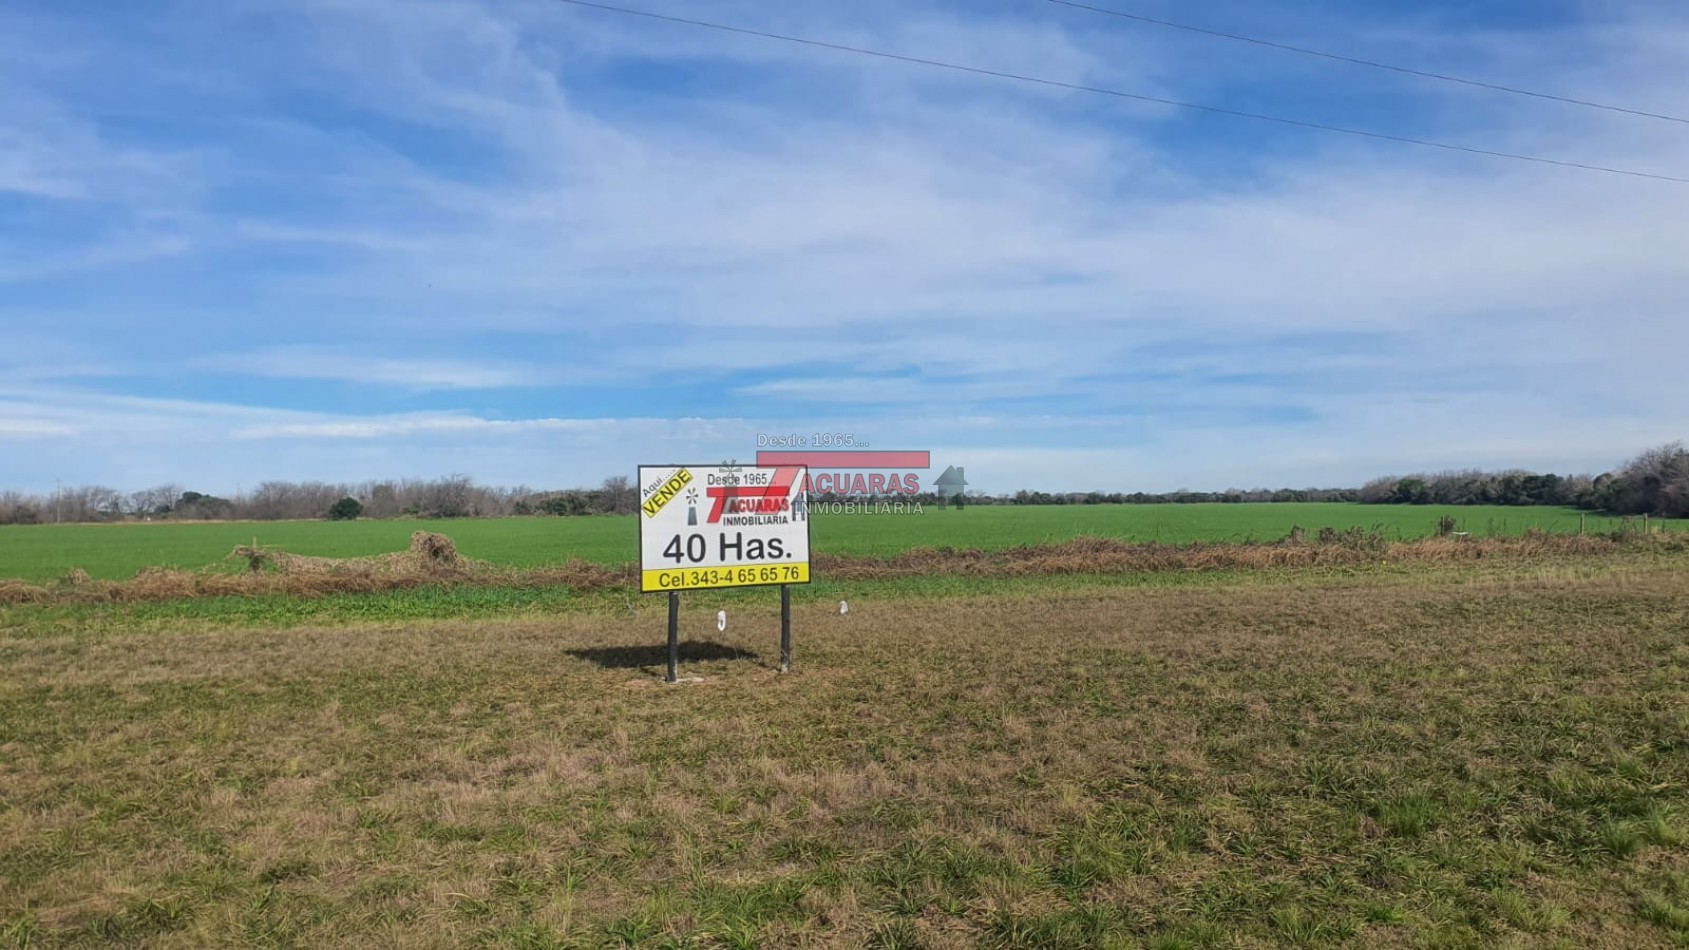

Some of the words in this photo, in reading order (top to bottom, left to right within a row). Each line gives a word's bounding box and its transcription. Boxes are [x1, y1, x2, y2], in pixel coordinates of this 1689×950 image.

[707, 473, 740, 485] Desde
[642, 469, 691, 515] VENDE
[722, 515, 789, 526] INMOBILIARIA
[662, 533, 706, 564] 40
[719, 531, 792, 562] Has.
[738, 568, 756, 583] 65
[760, 567, 778, 582] 65
[782, 566, 799, 580] 76
